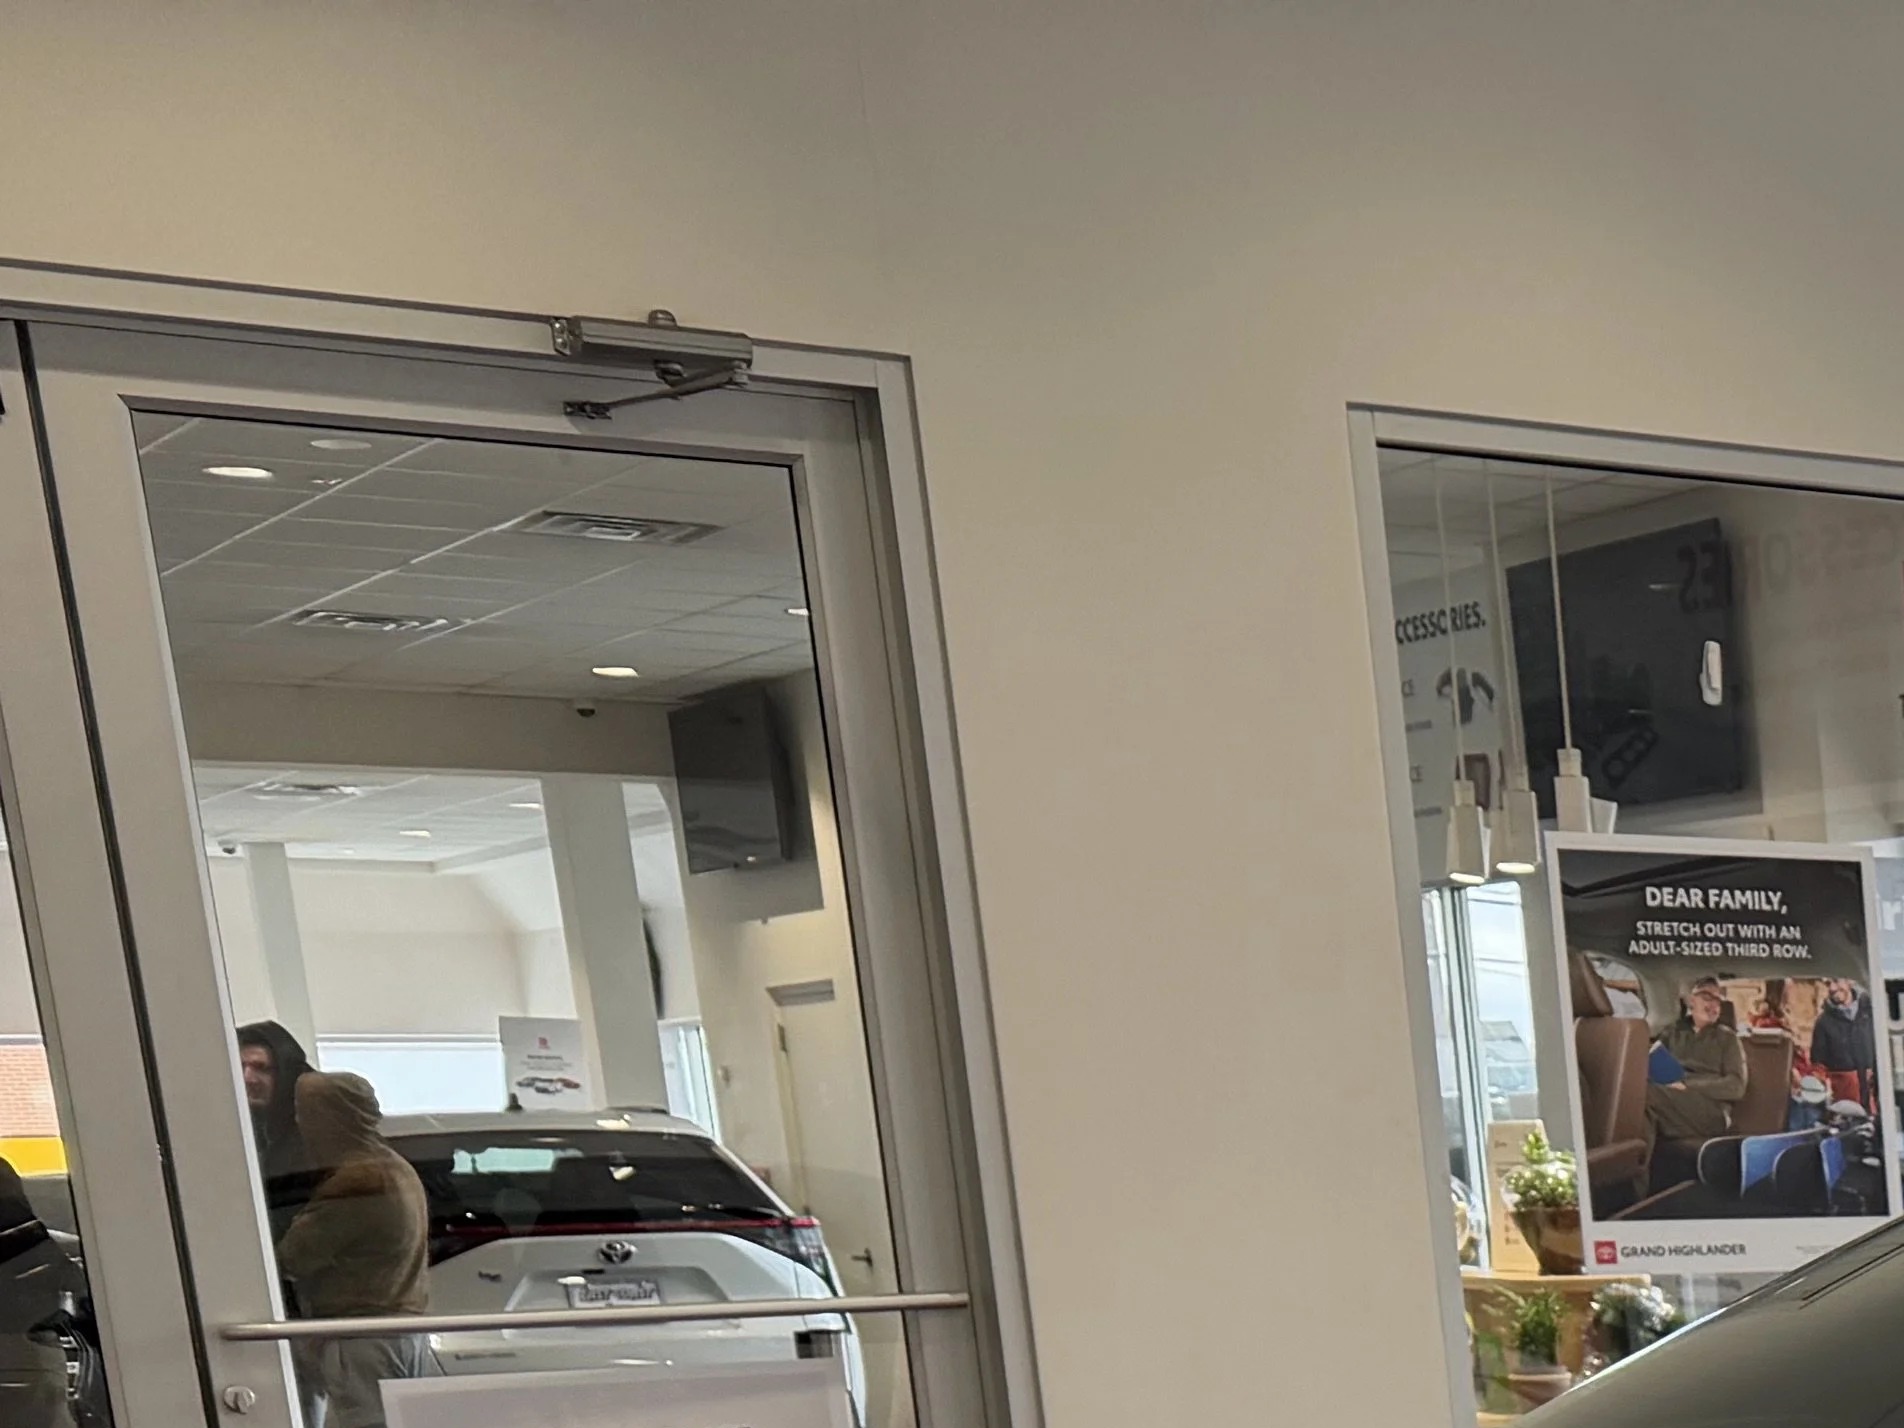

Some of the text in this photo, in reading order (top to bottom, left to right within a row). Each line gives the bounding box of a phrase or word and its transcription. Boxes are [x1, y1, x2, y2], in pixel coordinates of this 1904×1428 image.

[1394, 601, 1487, 645] CCESSORIES.
[1645, 886, 1788, 915] DEAR FAMILY,
[1636, 921, 1802, 940] STRETCH OUT WITH AN
[1628, 940, 1812, 959] ADULT-SIZED THIRD ROW.
[1620, 1243, 1748, 1258] GRAND HIGHLANDER
